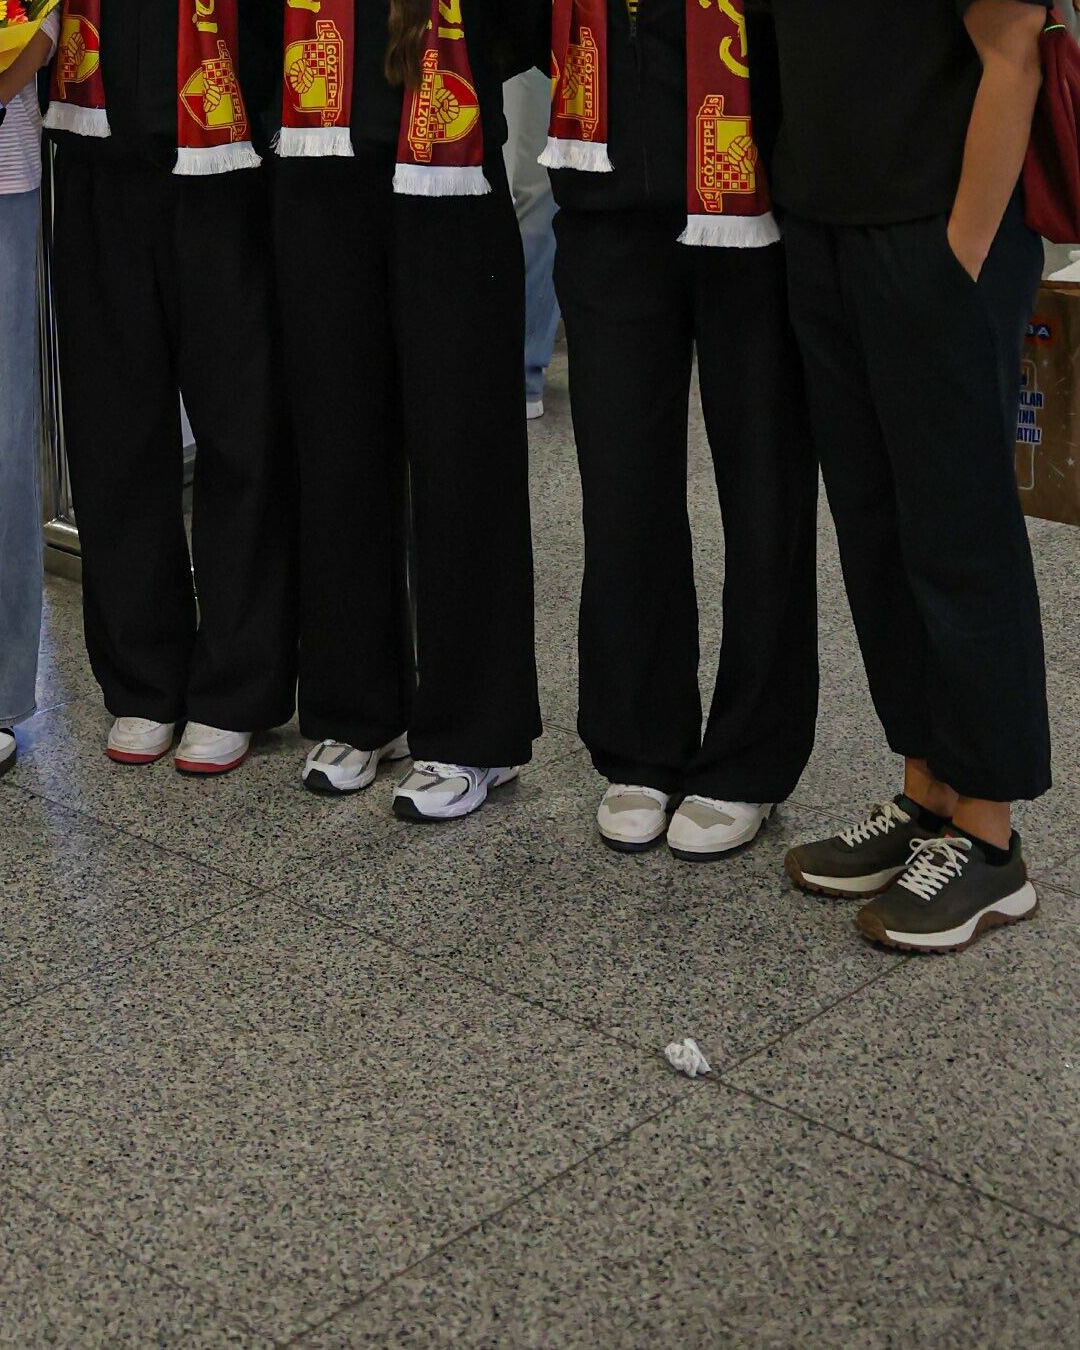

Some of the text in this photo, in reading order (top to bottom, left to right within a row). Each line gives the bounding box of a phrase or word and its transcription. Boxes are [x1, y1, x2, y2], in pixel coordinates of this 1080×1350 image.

[326, 44, 339, 106] GÖZTEPE
[415, 74, 432, 137] GÖZTEPE
[584, 53, 594, 117] GÖZTEPE
[701, 121, 714, 186] GÖZTEPE
